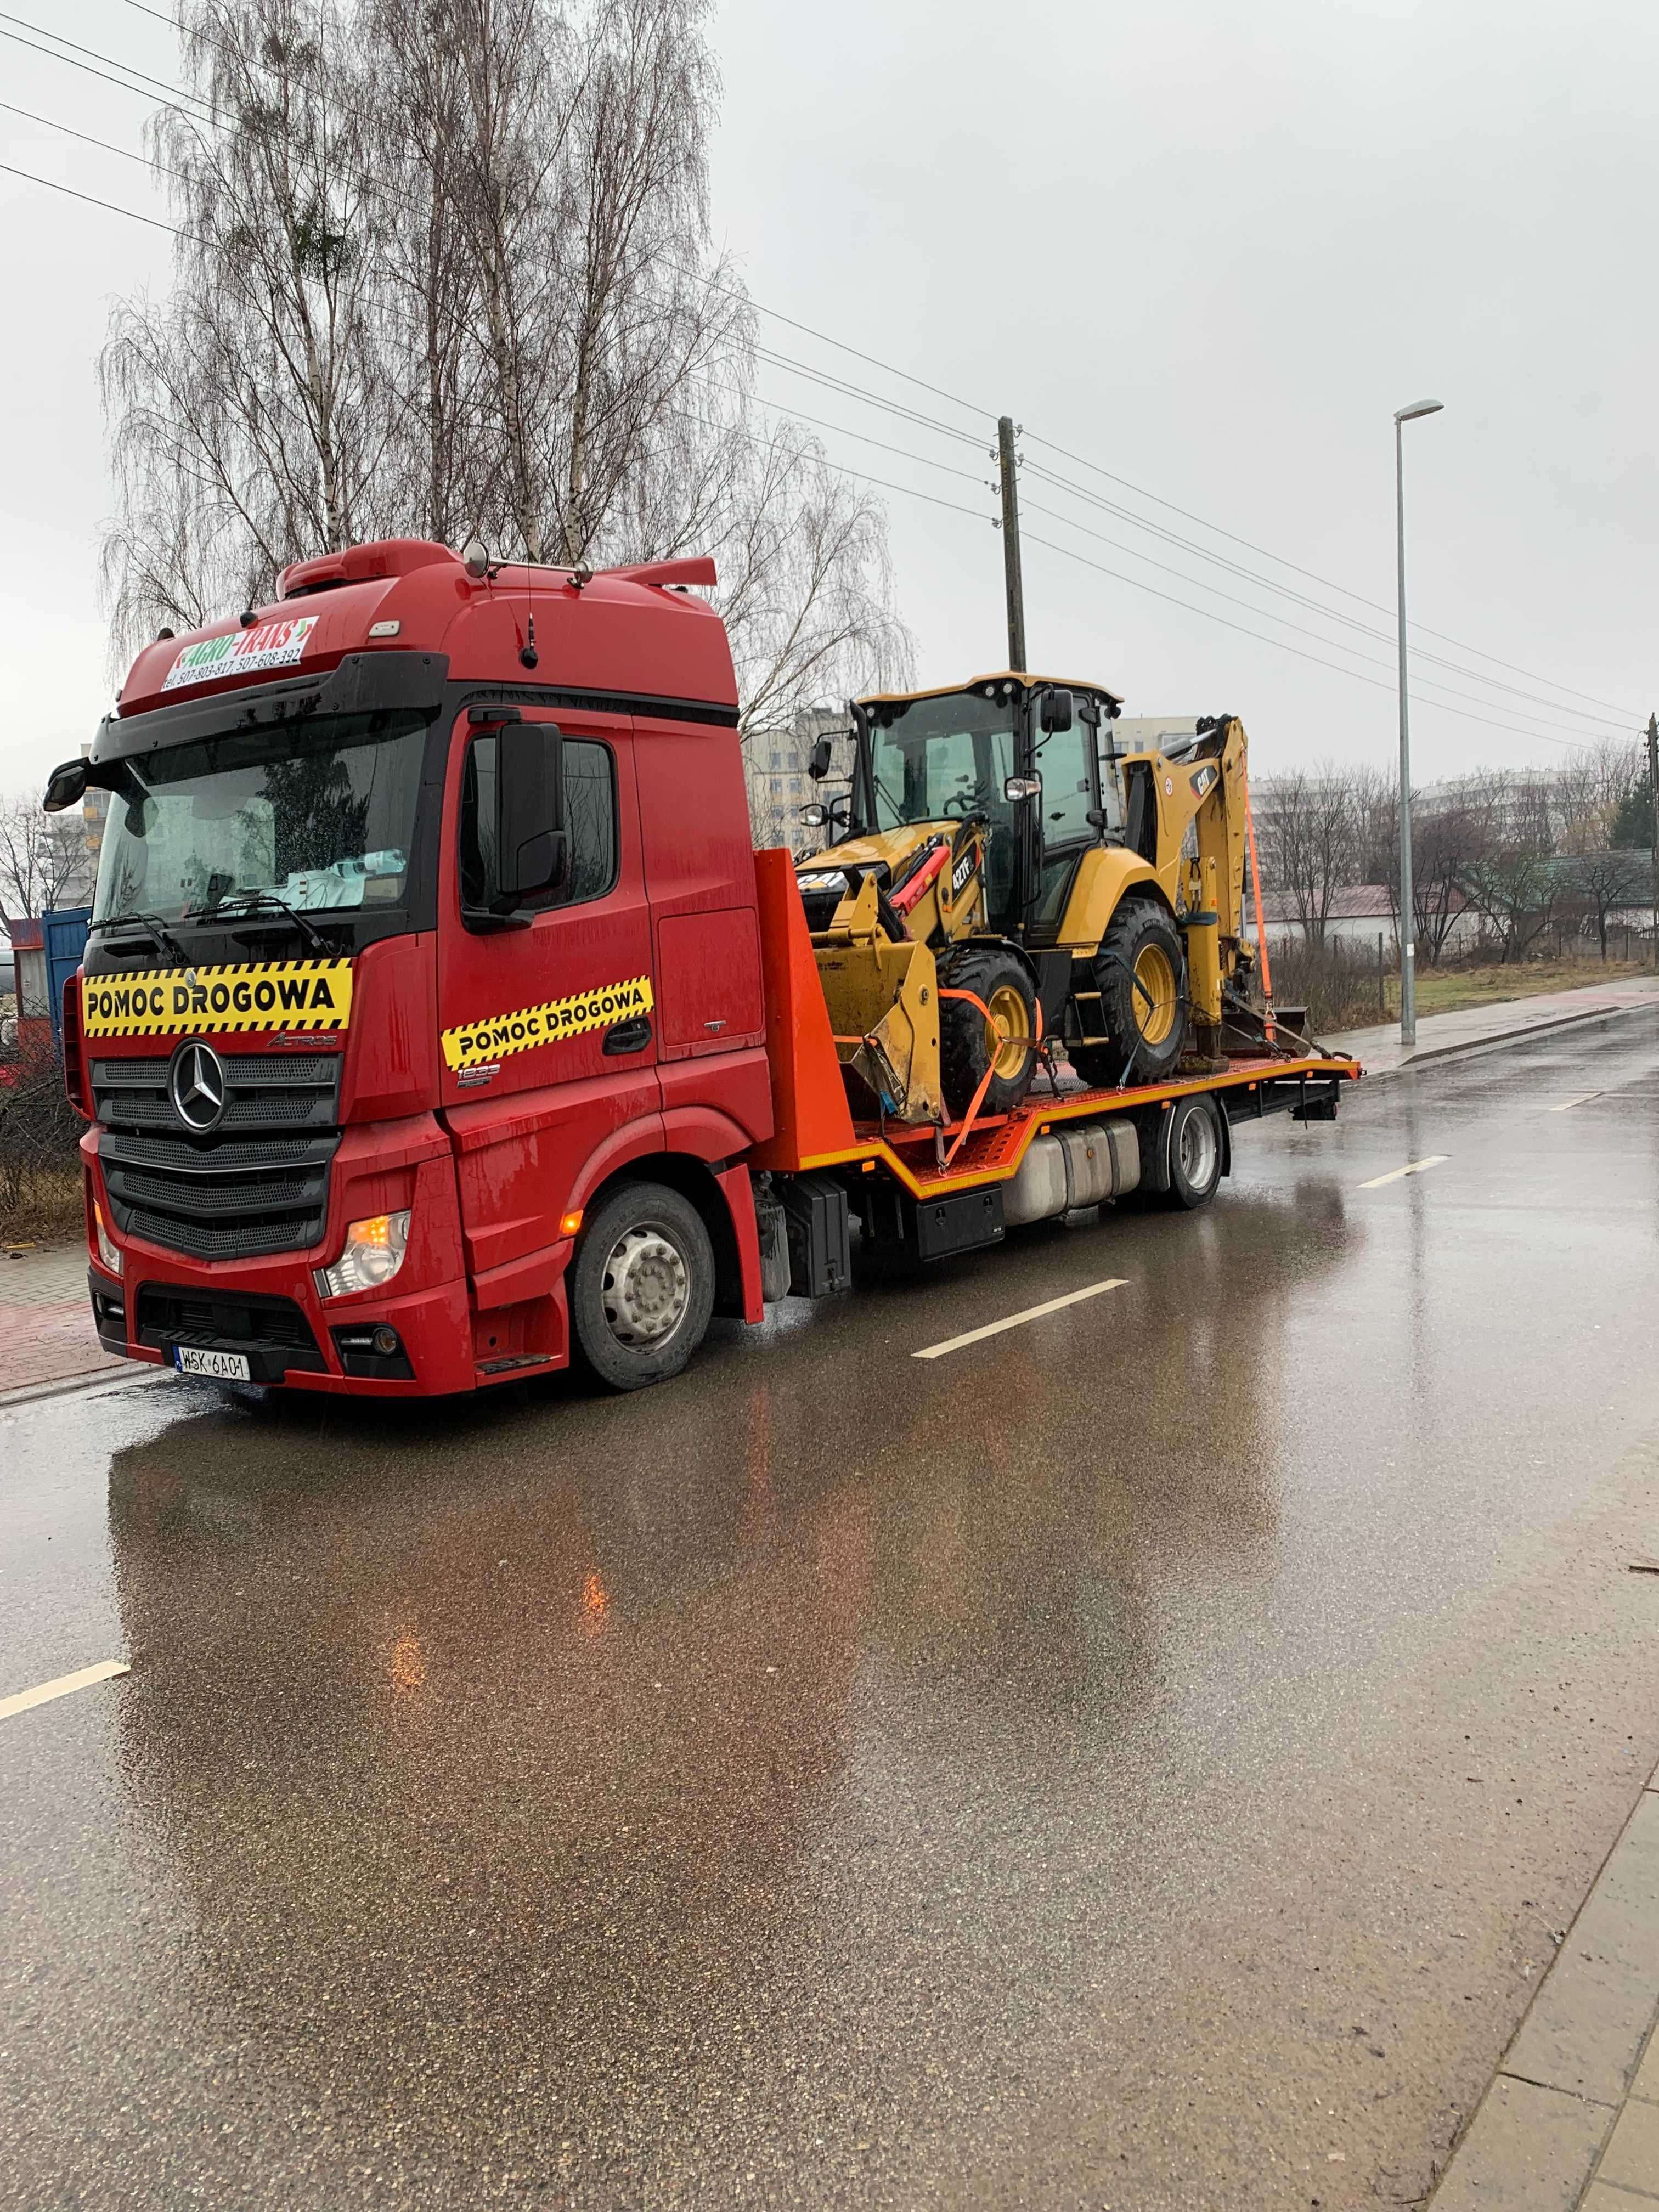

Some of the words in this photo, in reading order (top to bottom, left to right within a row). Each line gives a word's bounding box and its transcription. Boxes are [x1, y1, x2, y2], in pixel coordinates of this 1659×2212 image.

[236, 648, 300, 670] 507-608-392
[1197, 768, 1210, 795] CAT
[88, 987, 164, 1019] POMOC
[173, 978, 335, 1014] DROGOWA
[459, 1018, 540, 1056] POMOC
[545, 988, 644, 1031] DROGOWA
[458, 1064, 500, 1080] 1833
[182, 1350, 207, 1372] WSK
[212, 1355, 244, 1377] 6A01
